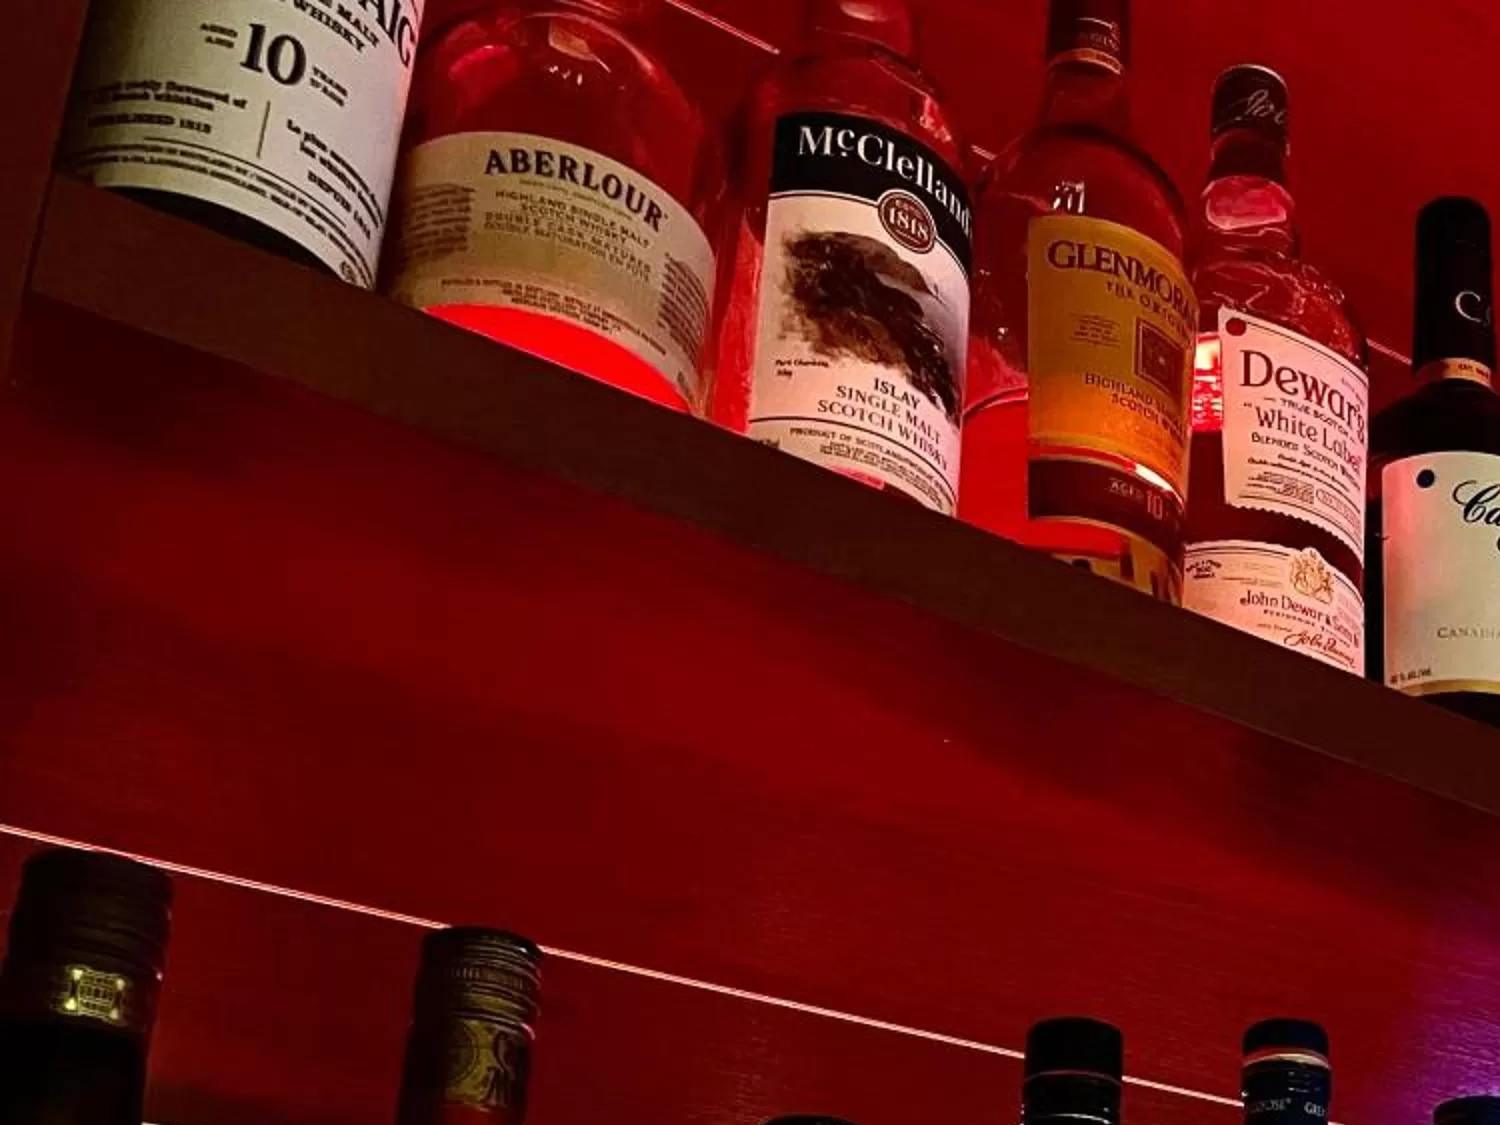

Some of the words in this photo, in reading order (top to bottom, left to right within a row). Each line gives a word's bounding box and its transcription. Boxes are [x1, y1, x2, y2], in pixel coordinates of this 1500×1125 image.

[240, 23, 307, 86] 10
[484, 149, 668, 233] ABERLOUR
[495, 190, 567, 212] HIGHLAND
[570, 203, 616, 230] SINGLE
[888, 206, 930, 240] 1818
[836, 385, 902, 418] SINGLE
[905, 412, 942, 445] MALT
[873, 377, 921, 411] ISLAY
[817, 399, 894, 434] SCOTCH
[898, 424, 949, 471] WHISKY
[1255, 405, 1319, 442] White
